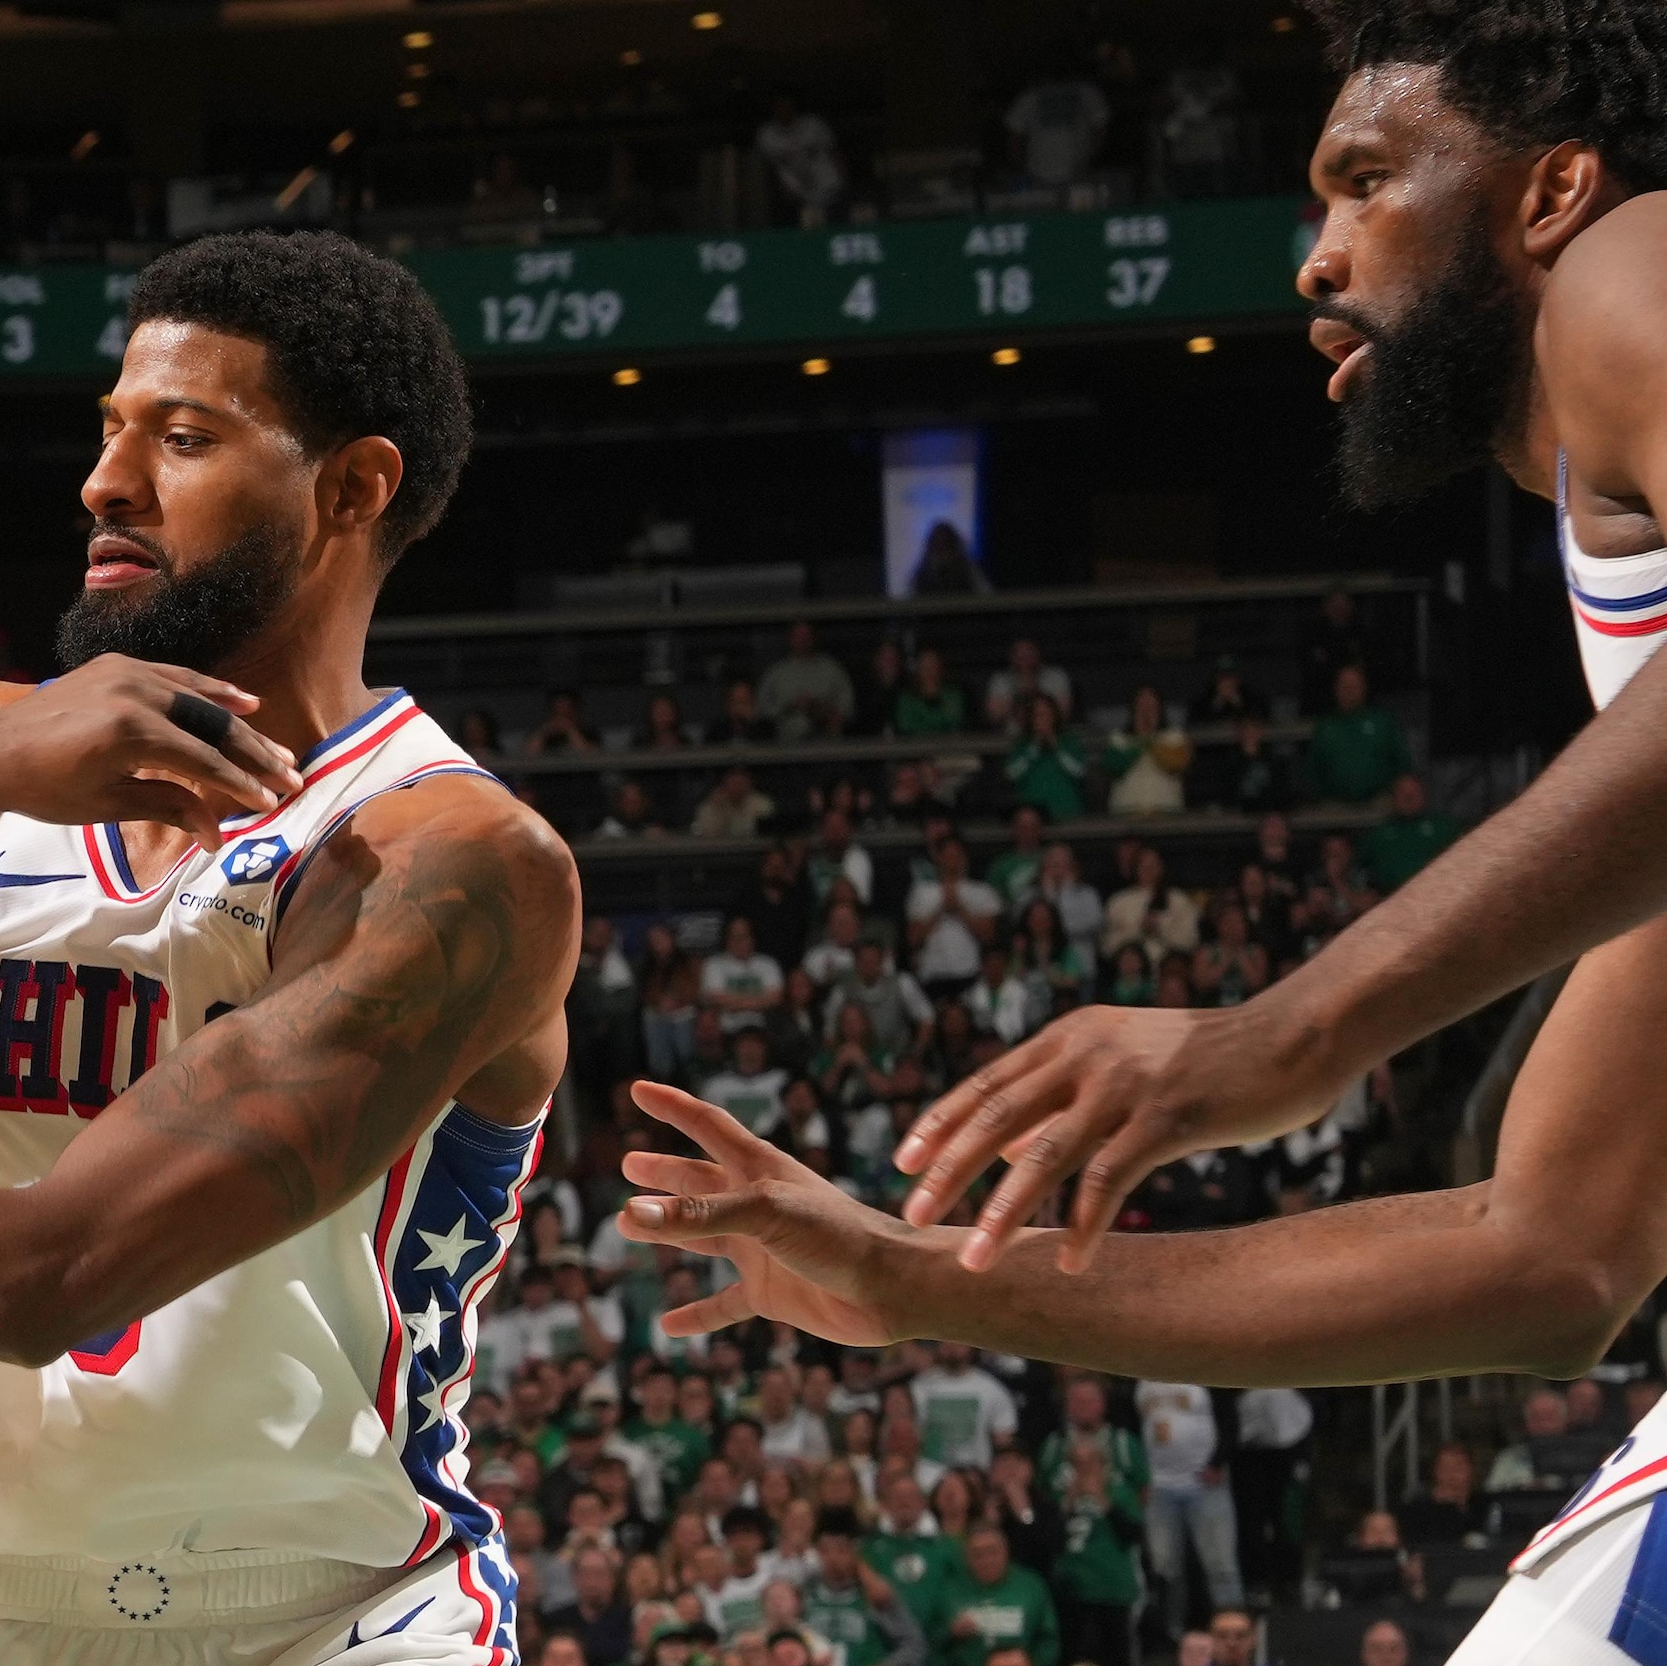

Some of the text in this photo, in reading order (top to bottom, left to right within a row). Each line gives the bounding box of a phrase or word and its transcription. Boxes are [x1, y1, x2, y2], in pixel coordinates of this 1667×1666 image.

[697, 241, 746, 272] TO
[964, 223, 1028, 255] AST
[480, 257, 1171, 343] 12/39 4 4 18 37
[2, 315, 35, 363] 3
[178, 892, 265, 931] crypto.com
